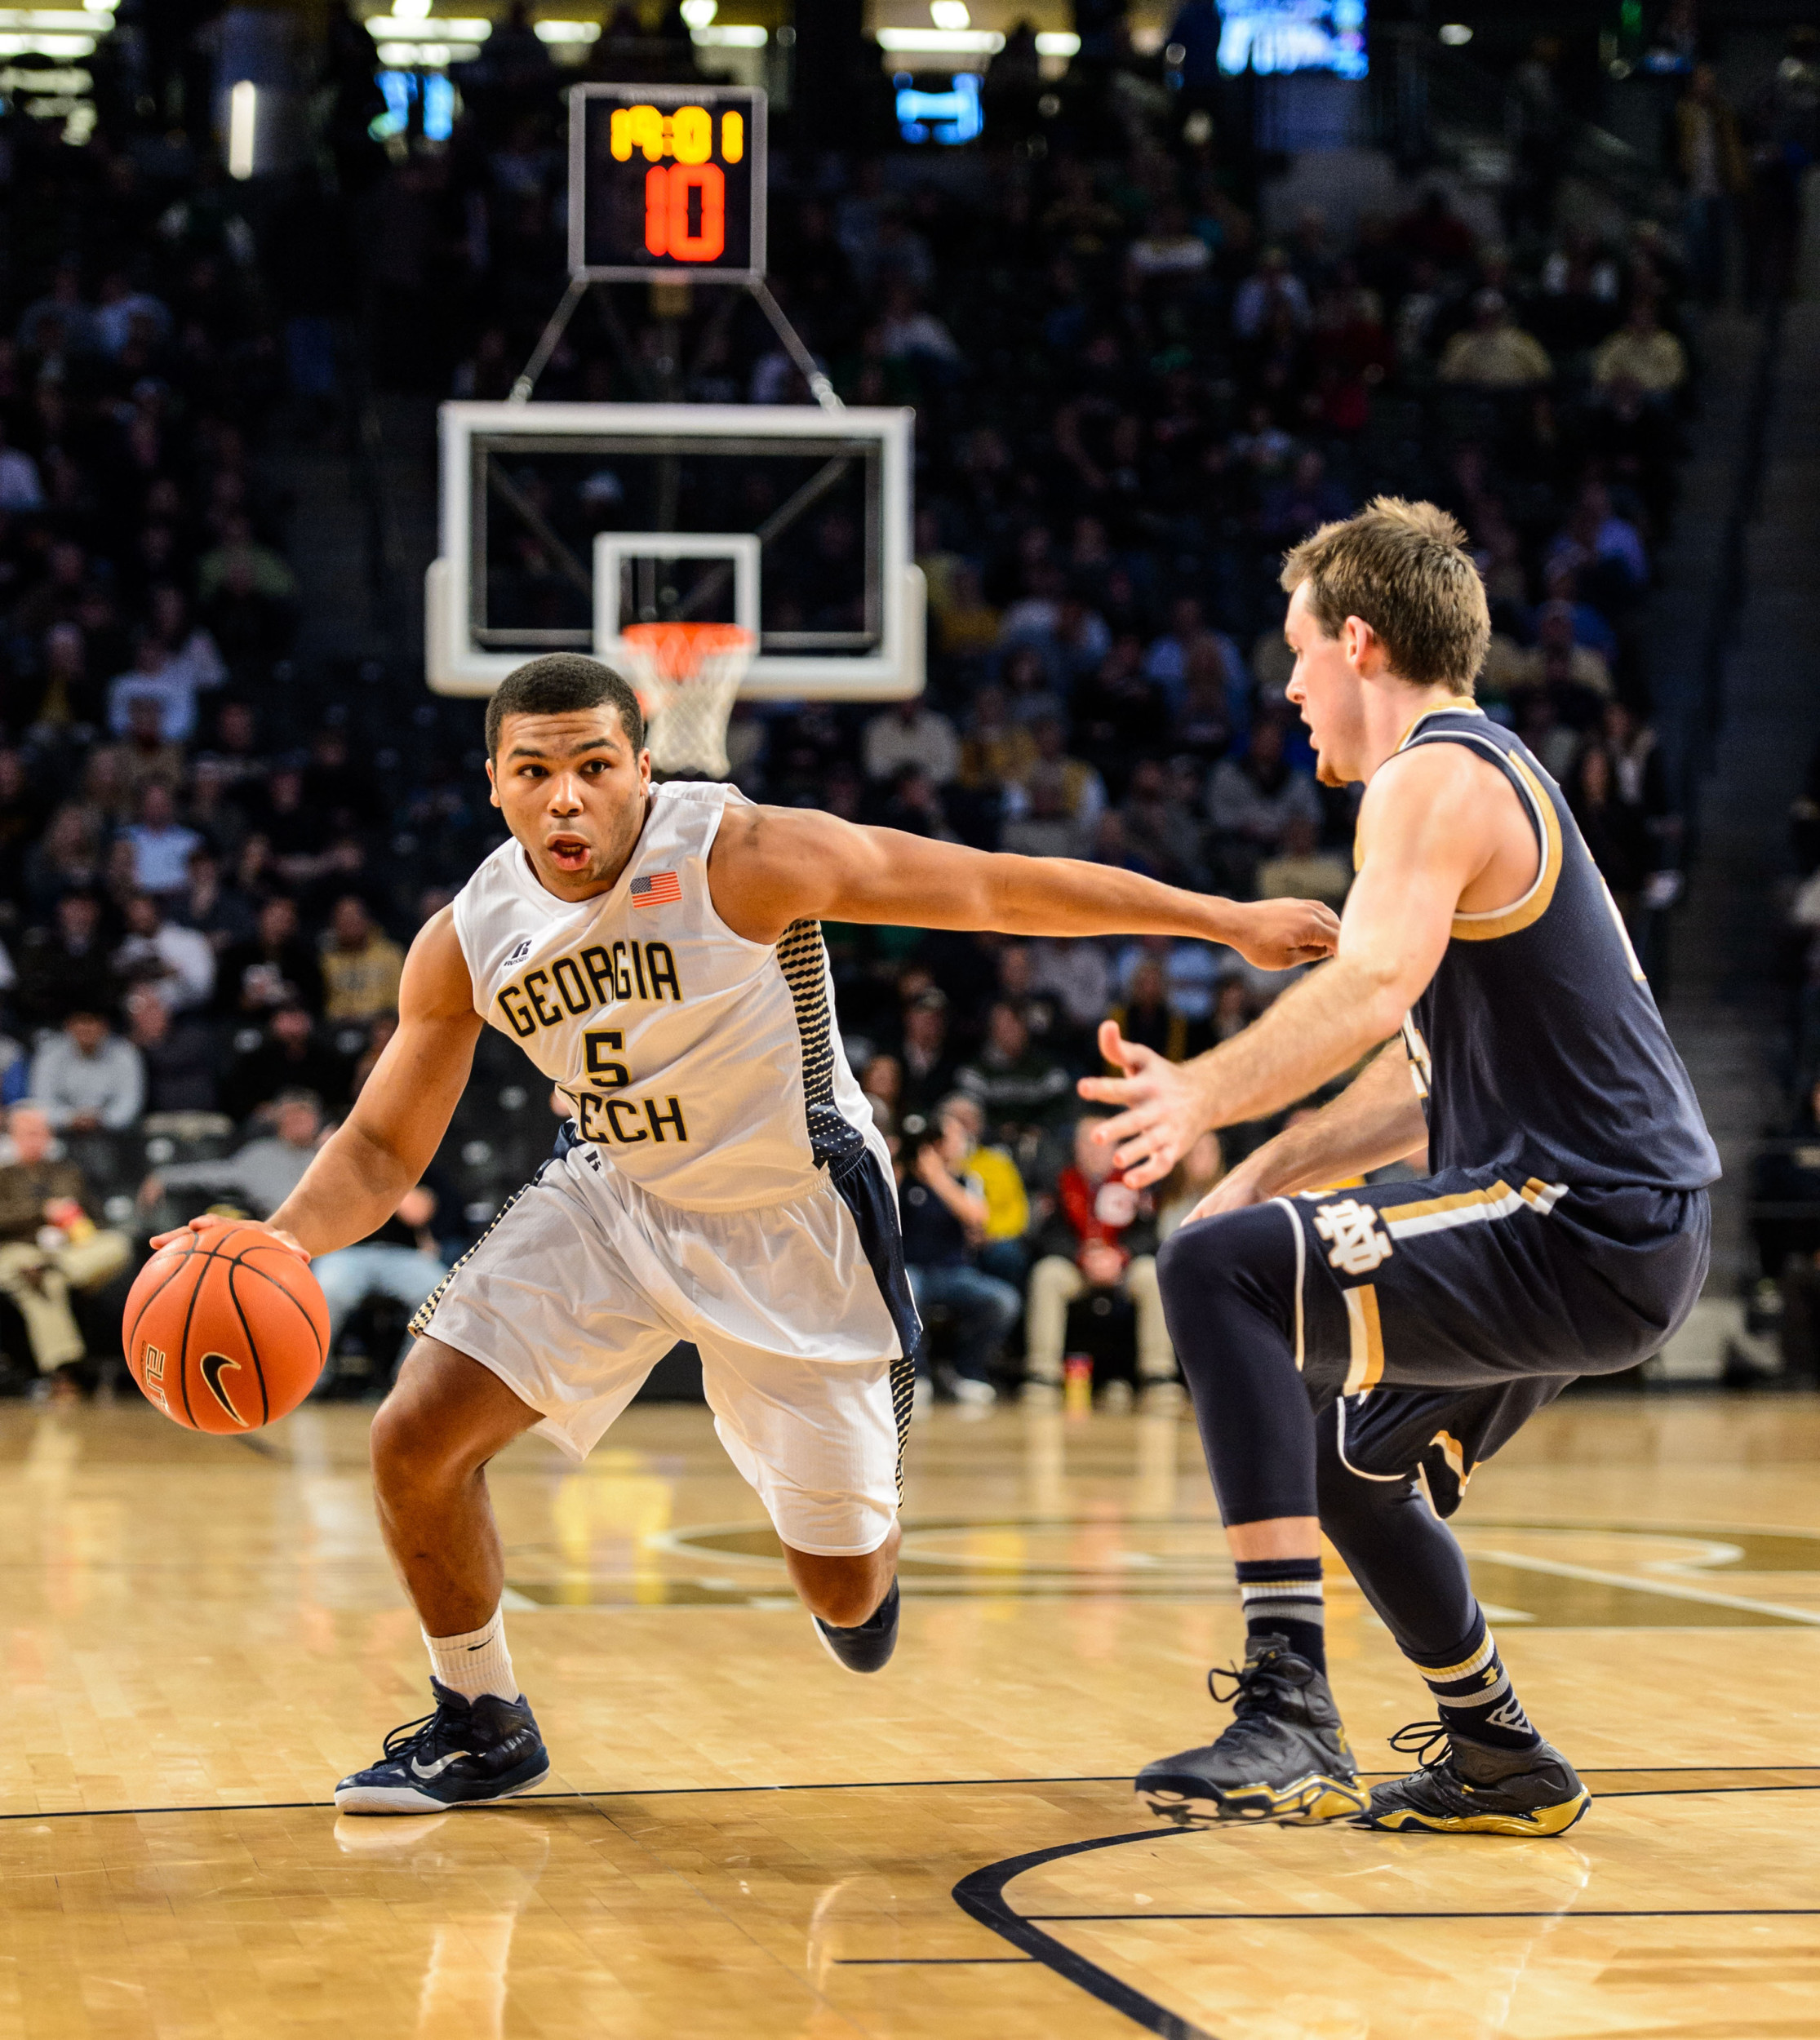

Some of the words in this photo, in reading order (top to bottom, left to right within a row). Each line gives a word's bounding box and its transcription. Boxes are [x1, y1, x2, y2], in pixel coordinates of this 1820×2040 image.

[610, 105, 744, 166] 19:01
[646, 163, 725, 261] 10
[497, 940, 683, 1038] GEORGIA
[582, 1028, 631, 1088] 5
[557, 1085, 689, 1144] ECH
